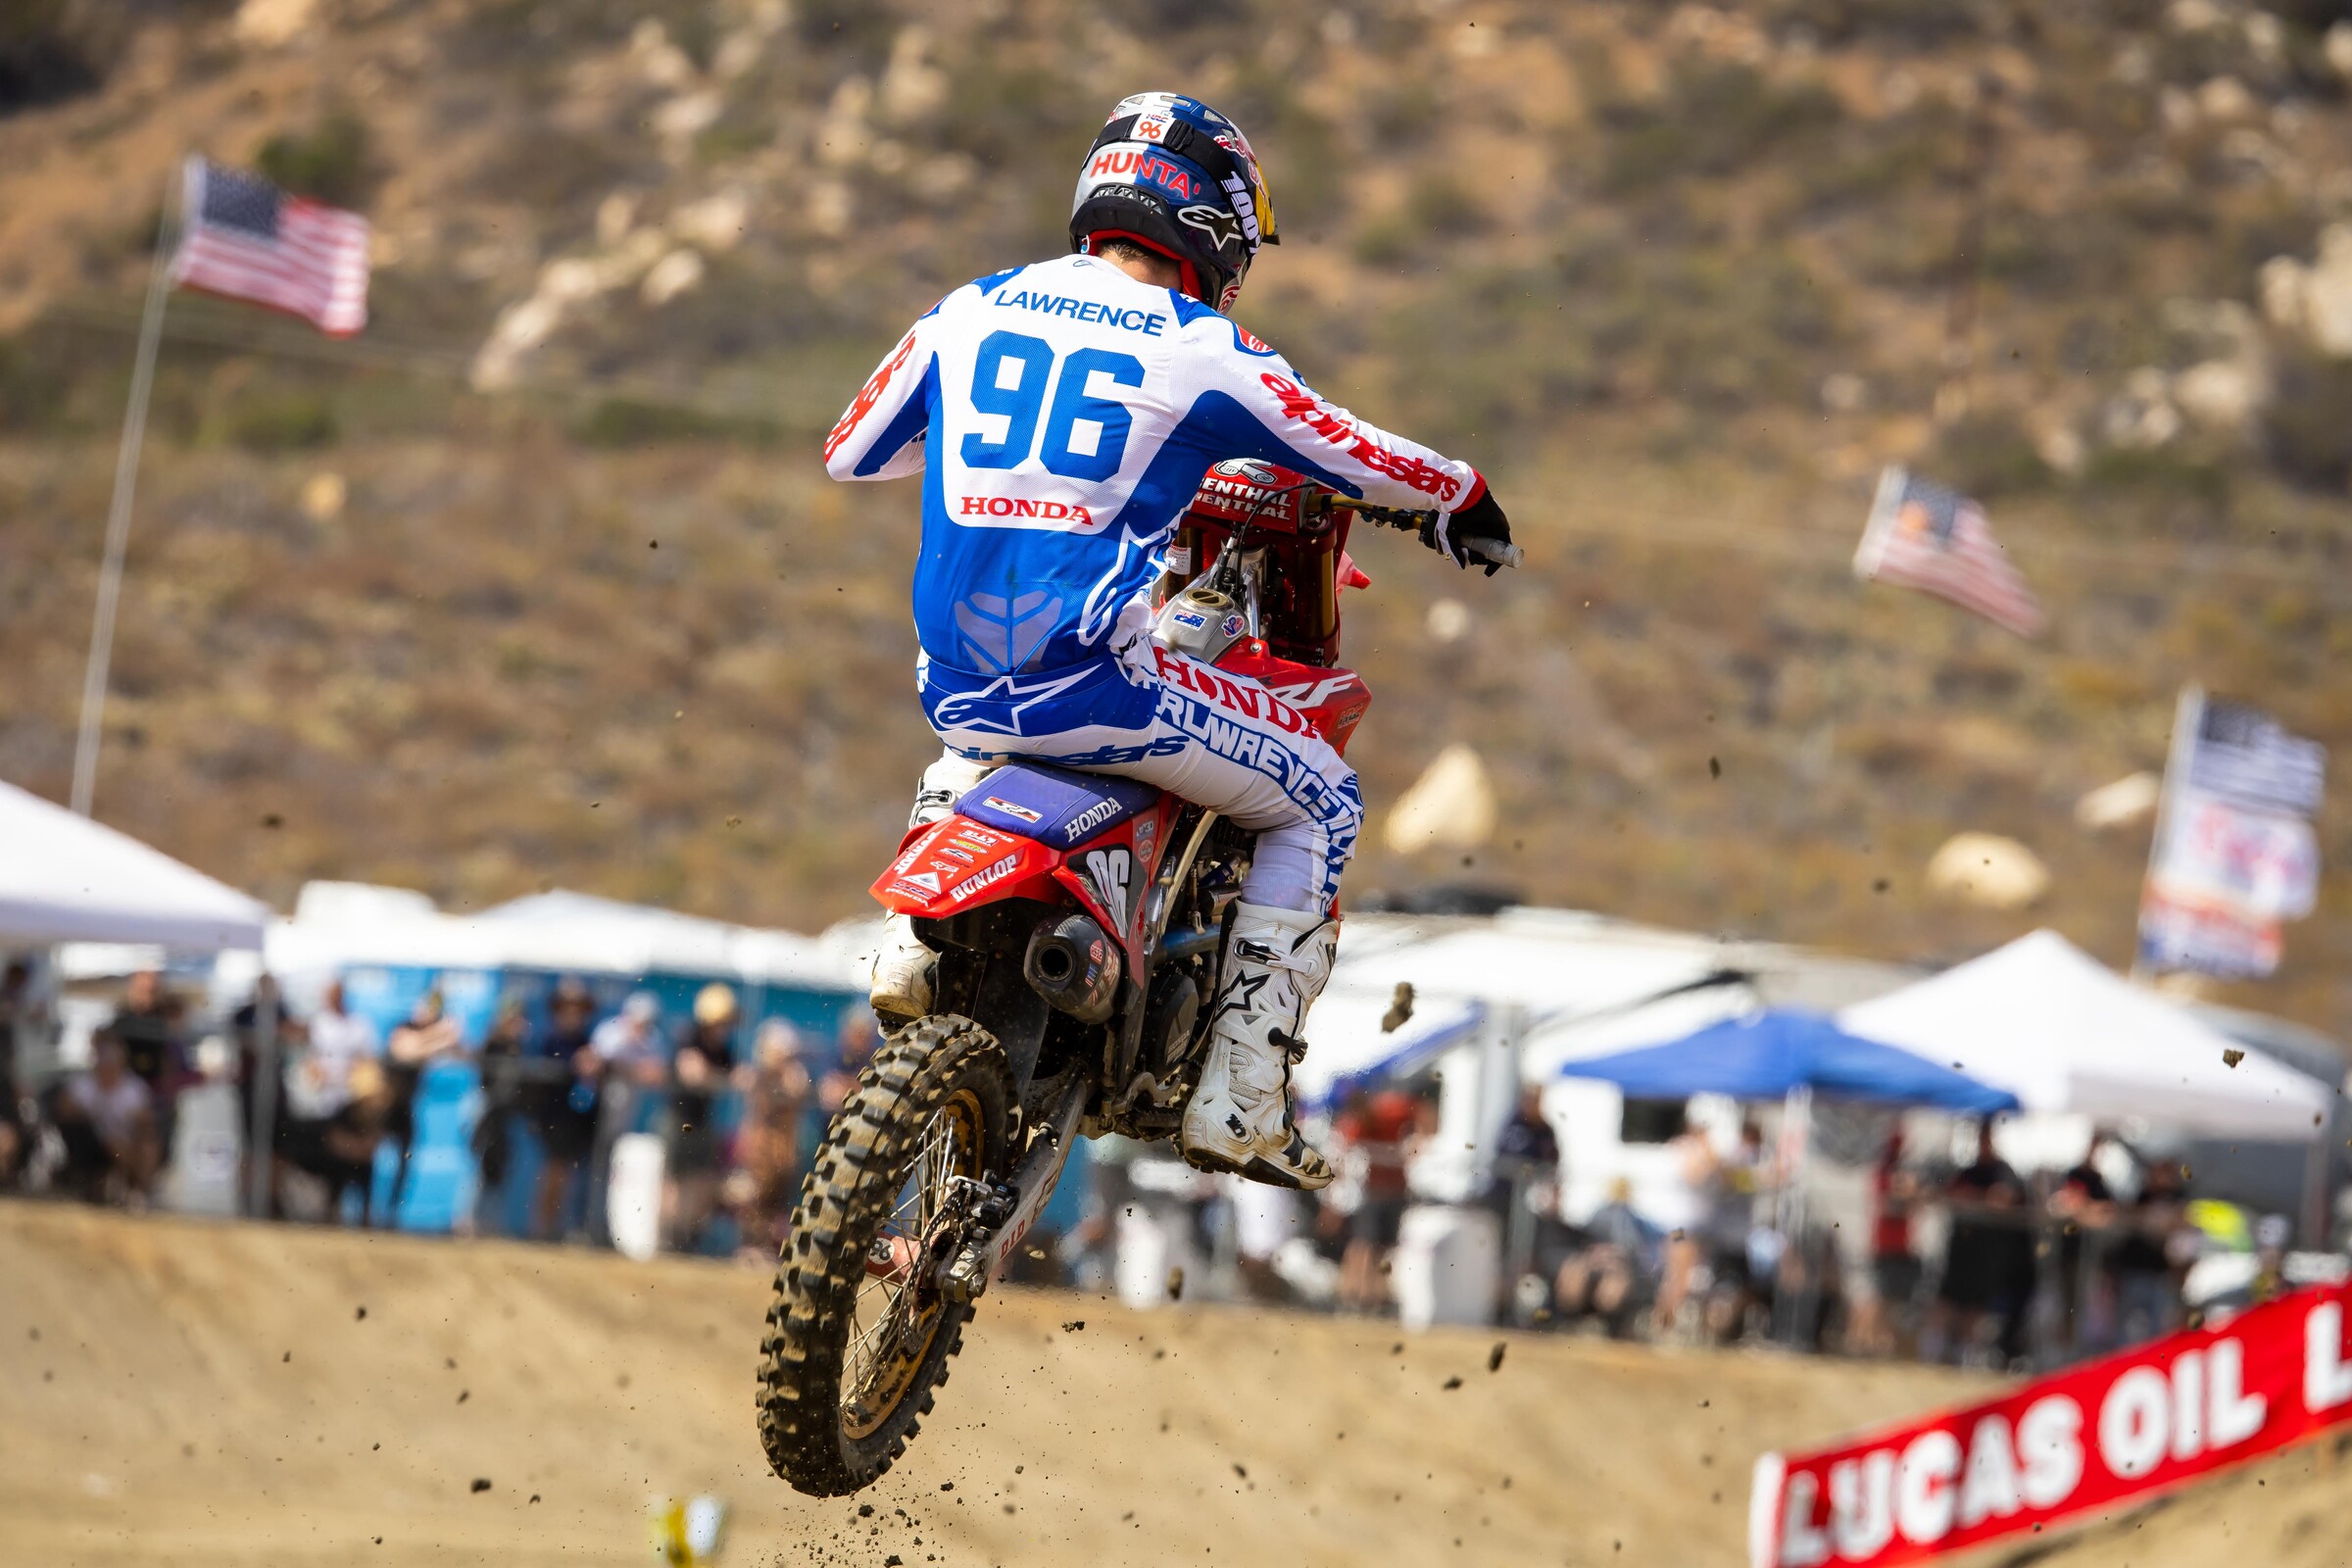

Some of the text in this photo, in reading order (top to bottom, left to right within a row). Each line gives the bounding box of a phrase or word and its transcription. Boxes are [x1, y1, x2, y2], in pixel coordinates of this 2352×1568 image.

[1138, 121, 1162, 139] 96
[994, 290, 1167, 337] LAWRENCE
[959, 329, 1147, 483] 96
[959, 496, 1094, 526] HONDA
[1199, 476, 1292, 508] ENTHAL
[1064, 797, 1123, 843] HONDA
[949, 854, 1017, 903] DUNLOP
[869, 1240, 892, 1261] 96
[1777, 1393, 2087, 1567] LUCAS
[2096, 1336, 2268, 1479] OIL
